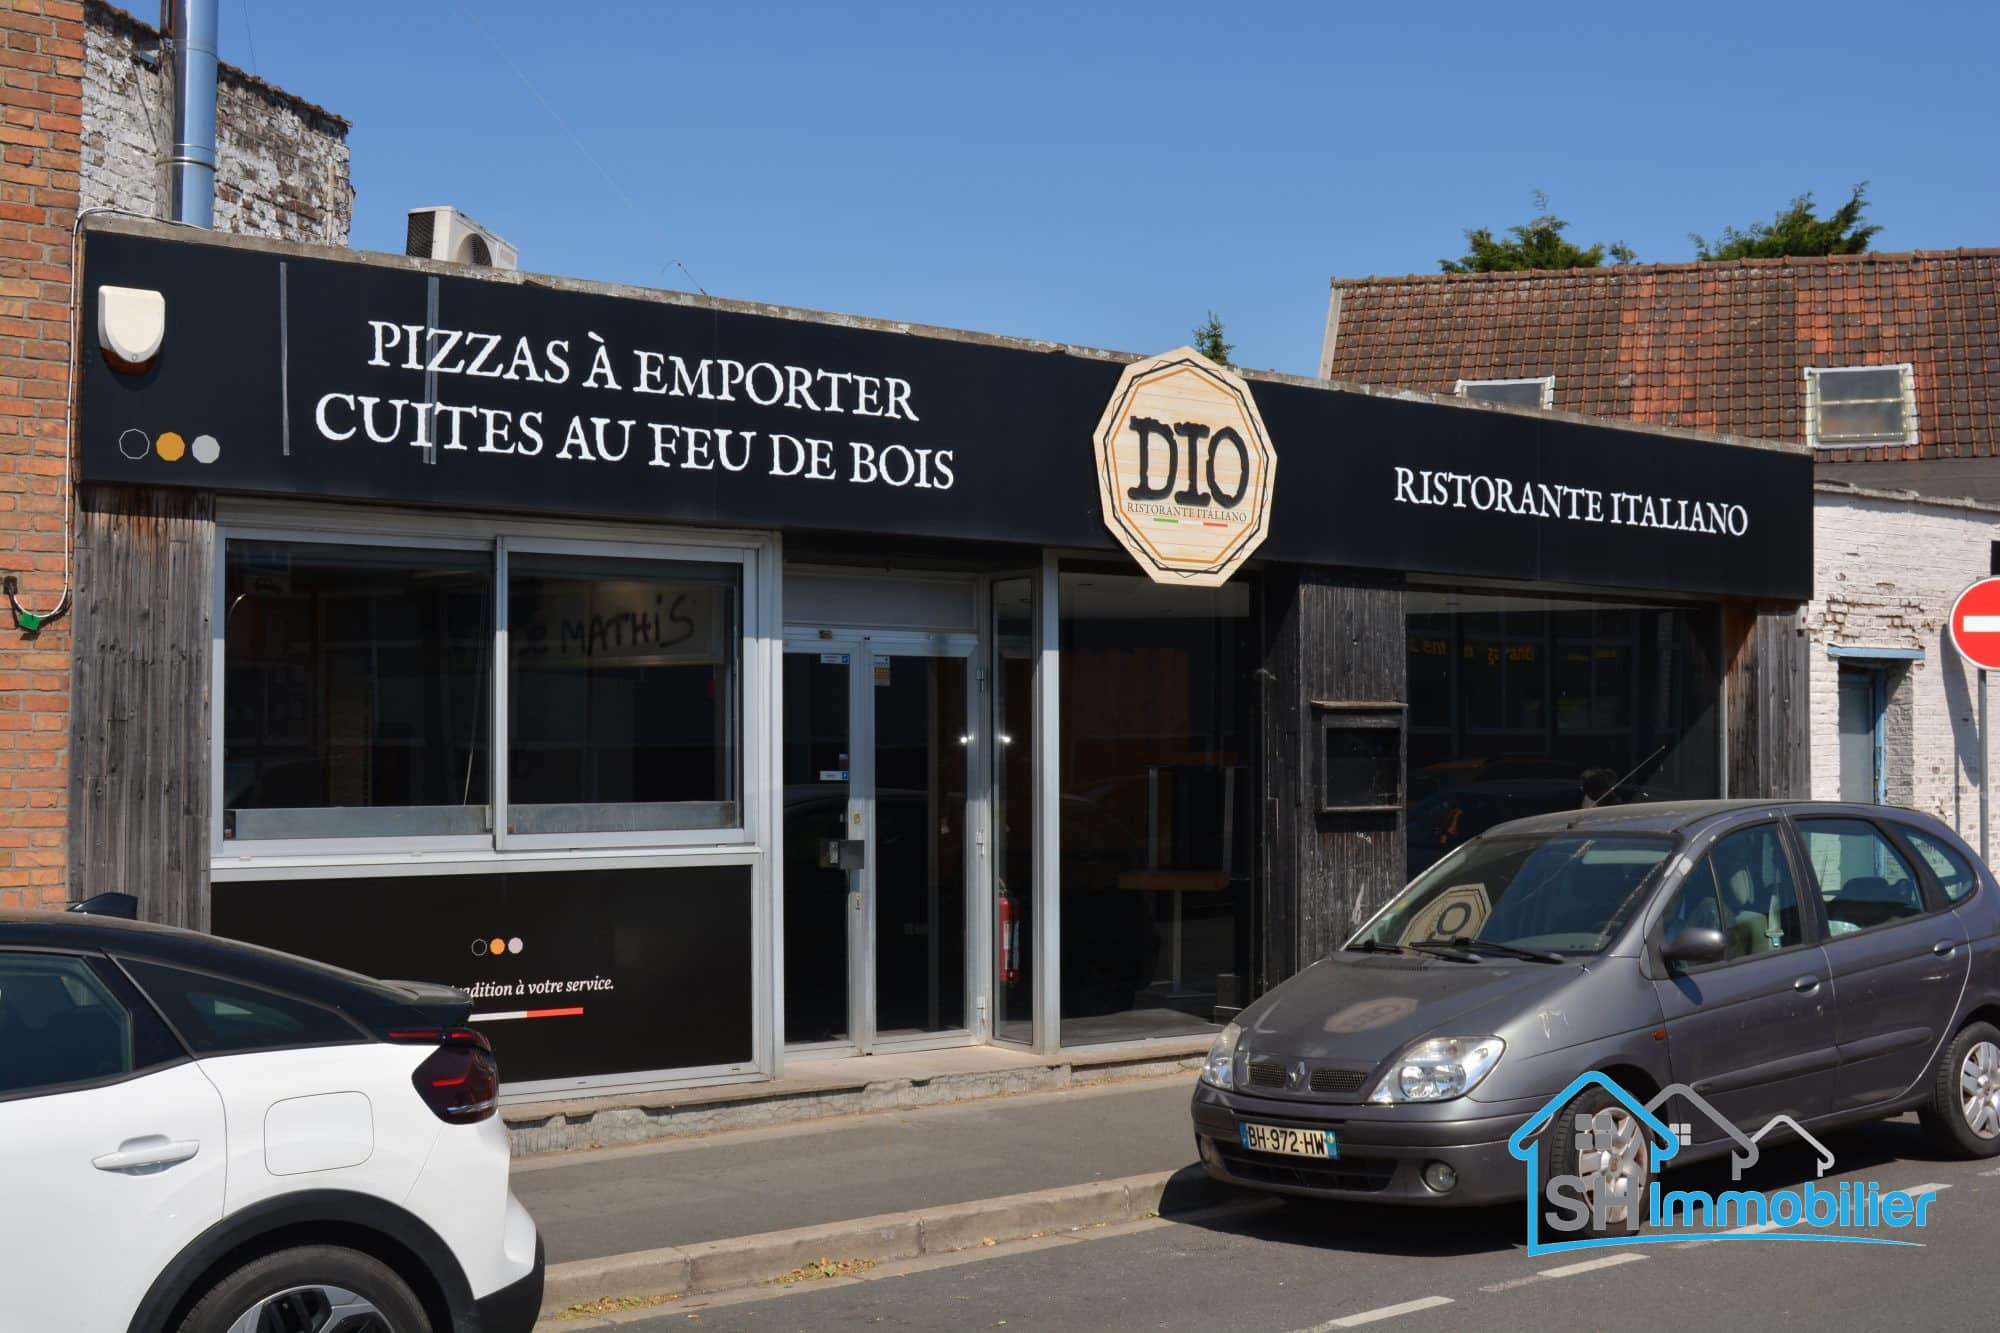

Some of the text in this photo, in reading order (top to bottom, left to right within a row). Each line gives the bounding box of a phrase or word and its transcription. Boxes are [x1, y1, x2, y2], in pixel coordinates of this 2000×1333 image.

[367, 320, 920, 422] PIZZAS À EMPORTER
[315, 392, 954, 490] CUITES AU FEU DE BOIS
[1127, 415, 1250, 509] DIO
[1127, 503, 1247, 522] RISTORANTE ITALIANO
[1394, 466, 1750, 537] RISTORANTE ITALIANO
[515, 979, 525, 995] à
[528, 979, 563, 994] votre
[566, 975, 614, 992] service.
[1247, 1126, 1325, 1155] BH-972-HW
